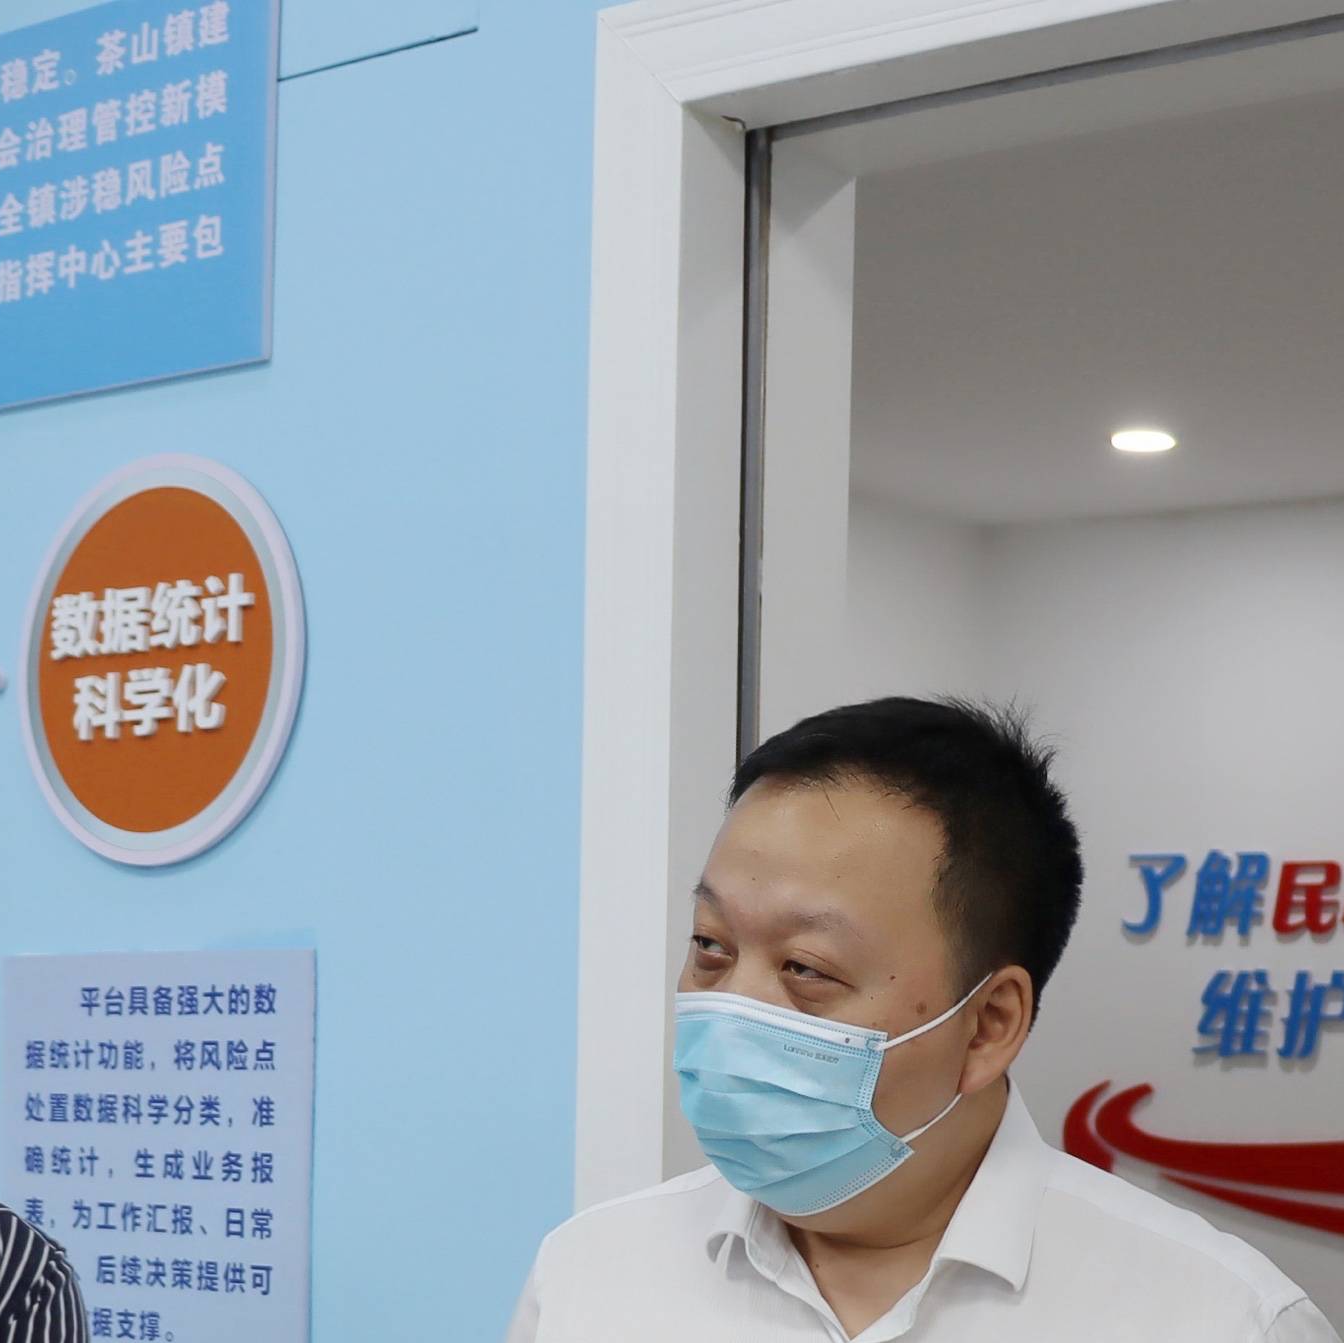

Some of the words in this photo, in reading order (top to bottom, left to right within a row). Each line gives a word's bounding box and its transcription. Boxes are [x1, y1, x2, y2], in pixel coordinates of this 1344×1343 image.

[49, 573, 255, 661] 数据统计
[71, 662, 227, 742] 科学化
[79, 984, 277, 1017] 平台具备强大的数
[24, 1040, 276, 1073] 据统计功能，将风险点
[23, 1093, 275, 1128] 处置数据科学分类，准
[23, 1145, 274, 1184] 确统计，生成业务报
[23, 1198, 273, 1240] 表，为工作汇报、日常
